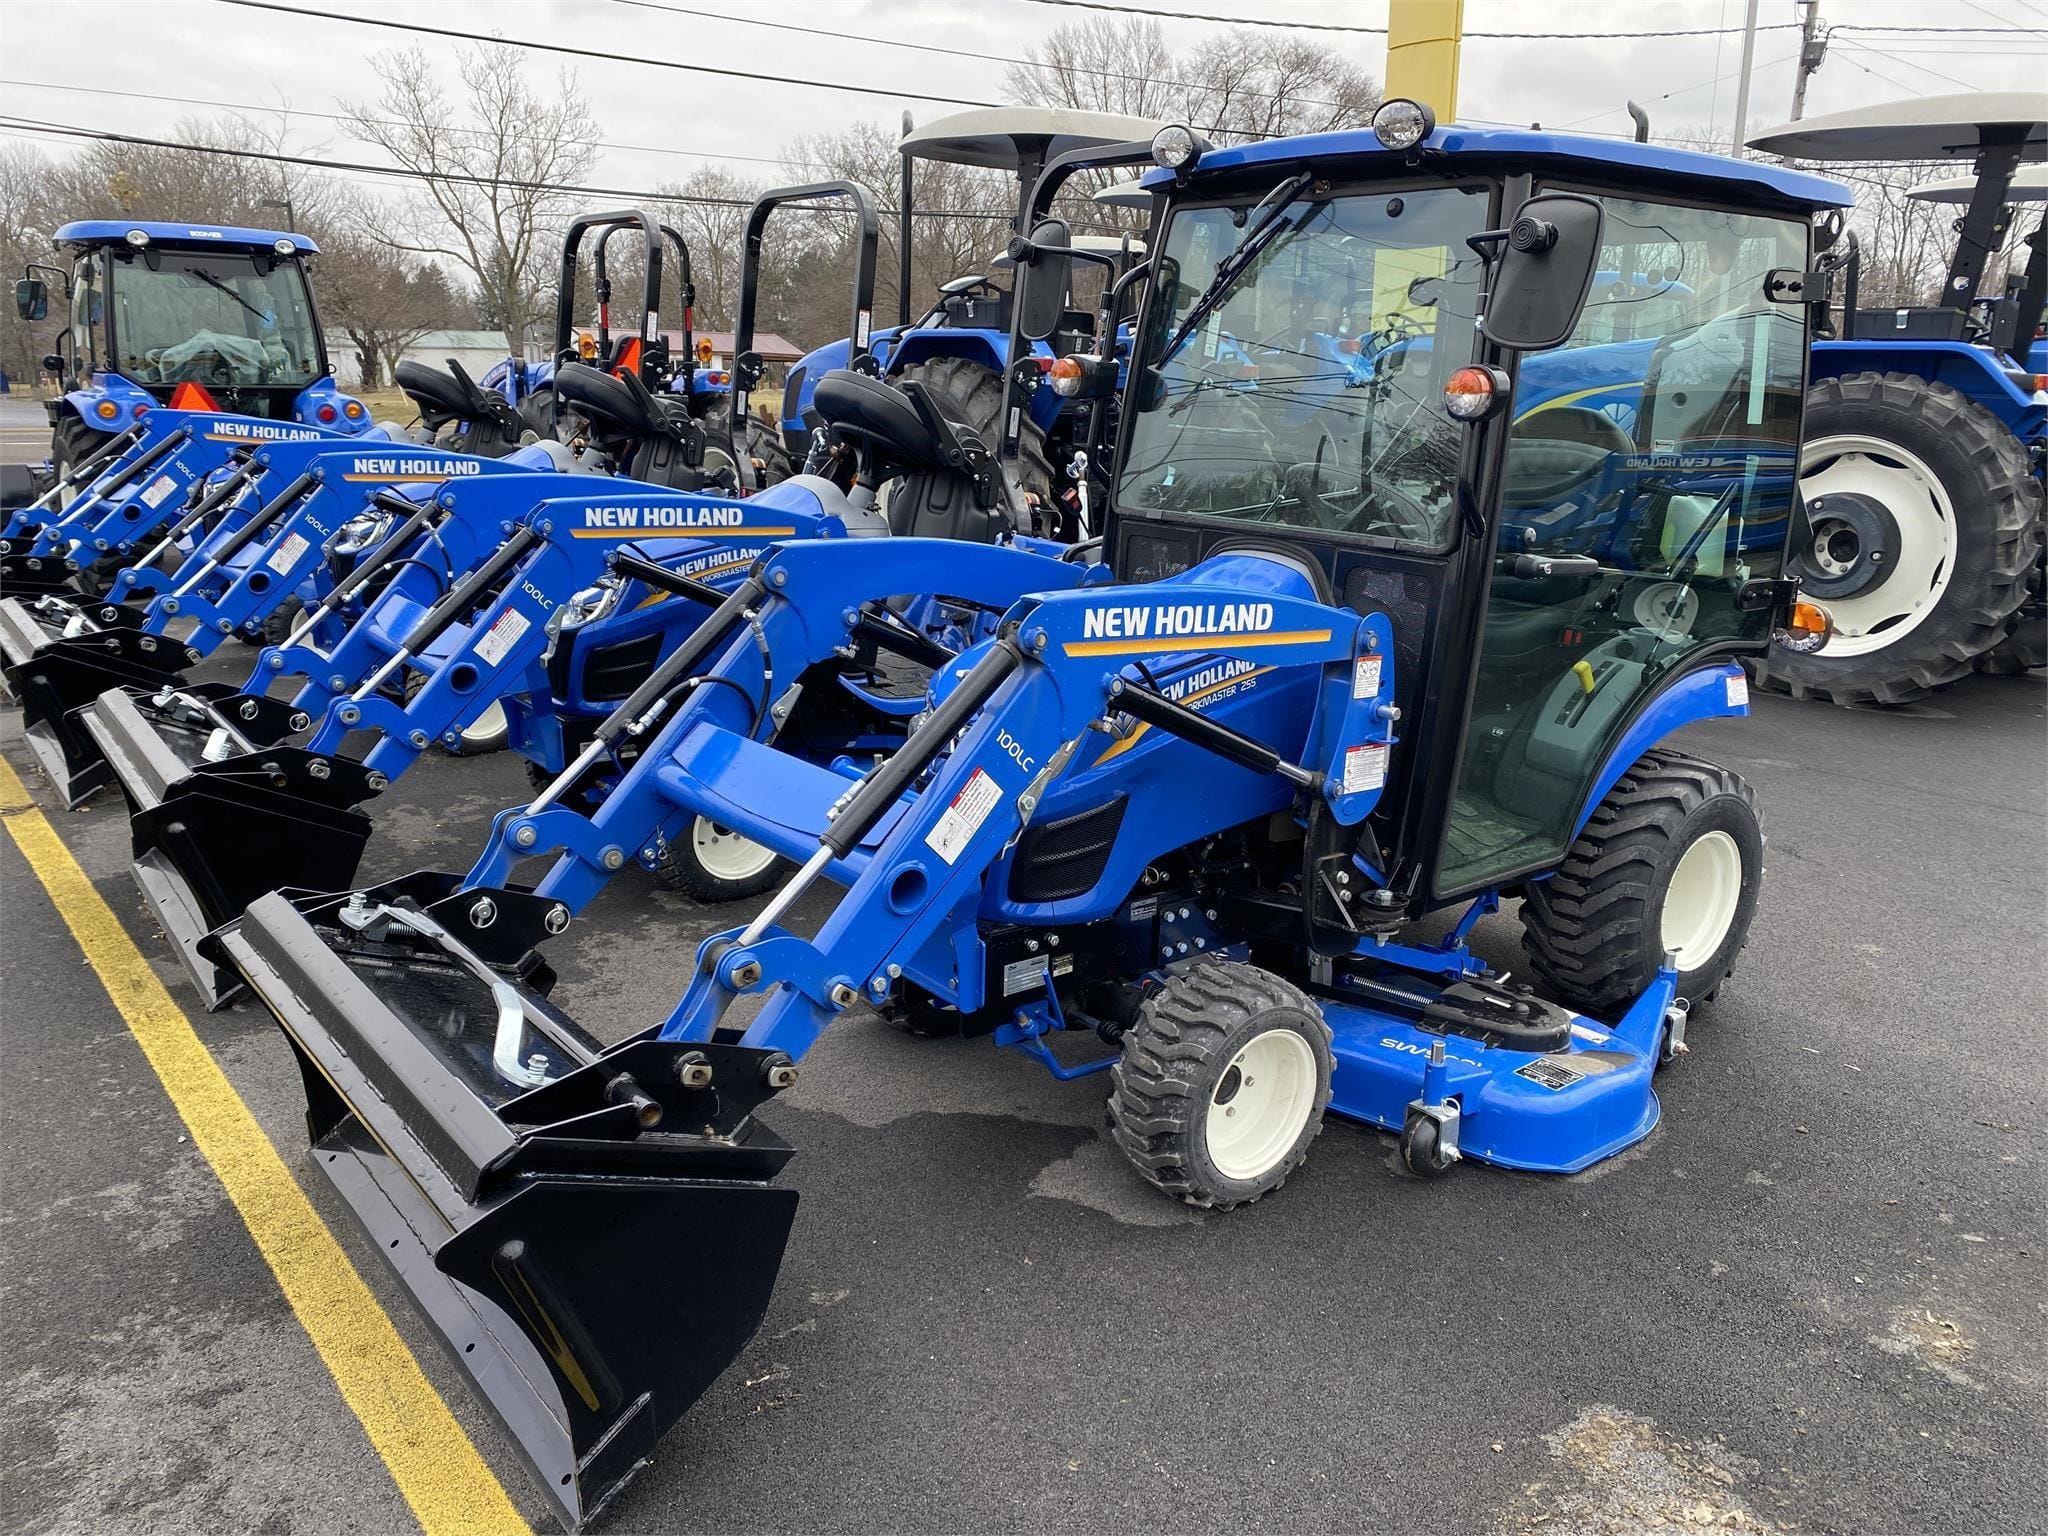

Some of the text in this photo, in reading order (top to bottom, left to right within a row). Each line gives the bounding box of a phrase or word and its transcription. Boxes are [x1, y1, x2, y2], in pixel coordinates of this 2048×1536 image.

[213, 421, 321, 441] NEW HOLLAND
[175, 460, 196, 480] 100LC
[354, 458, 480, 475] NEW HOLLAND
[304, 513, 330, 536] 100LC
[585, 507, 743, 527] NEW HOLLAND
[675, 557, 706, 577] NEW
[701, 564, 751, 584] WORKMASTER
[521, 579, 553, 610] 100LC
[1083, 603, 1274, 639] NEW HOLLAND
[1161, 659, 1256, 701] EW HOLLAND
[1187, 685, 1237, 711] ORKMASTER
[996, 728, 1035, 773] 100LC
